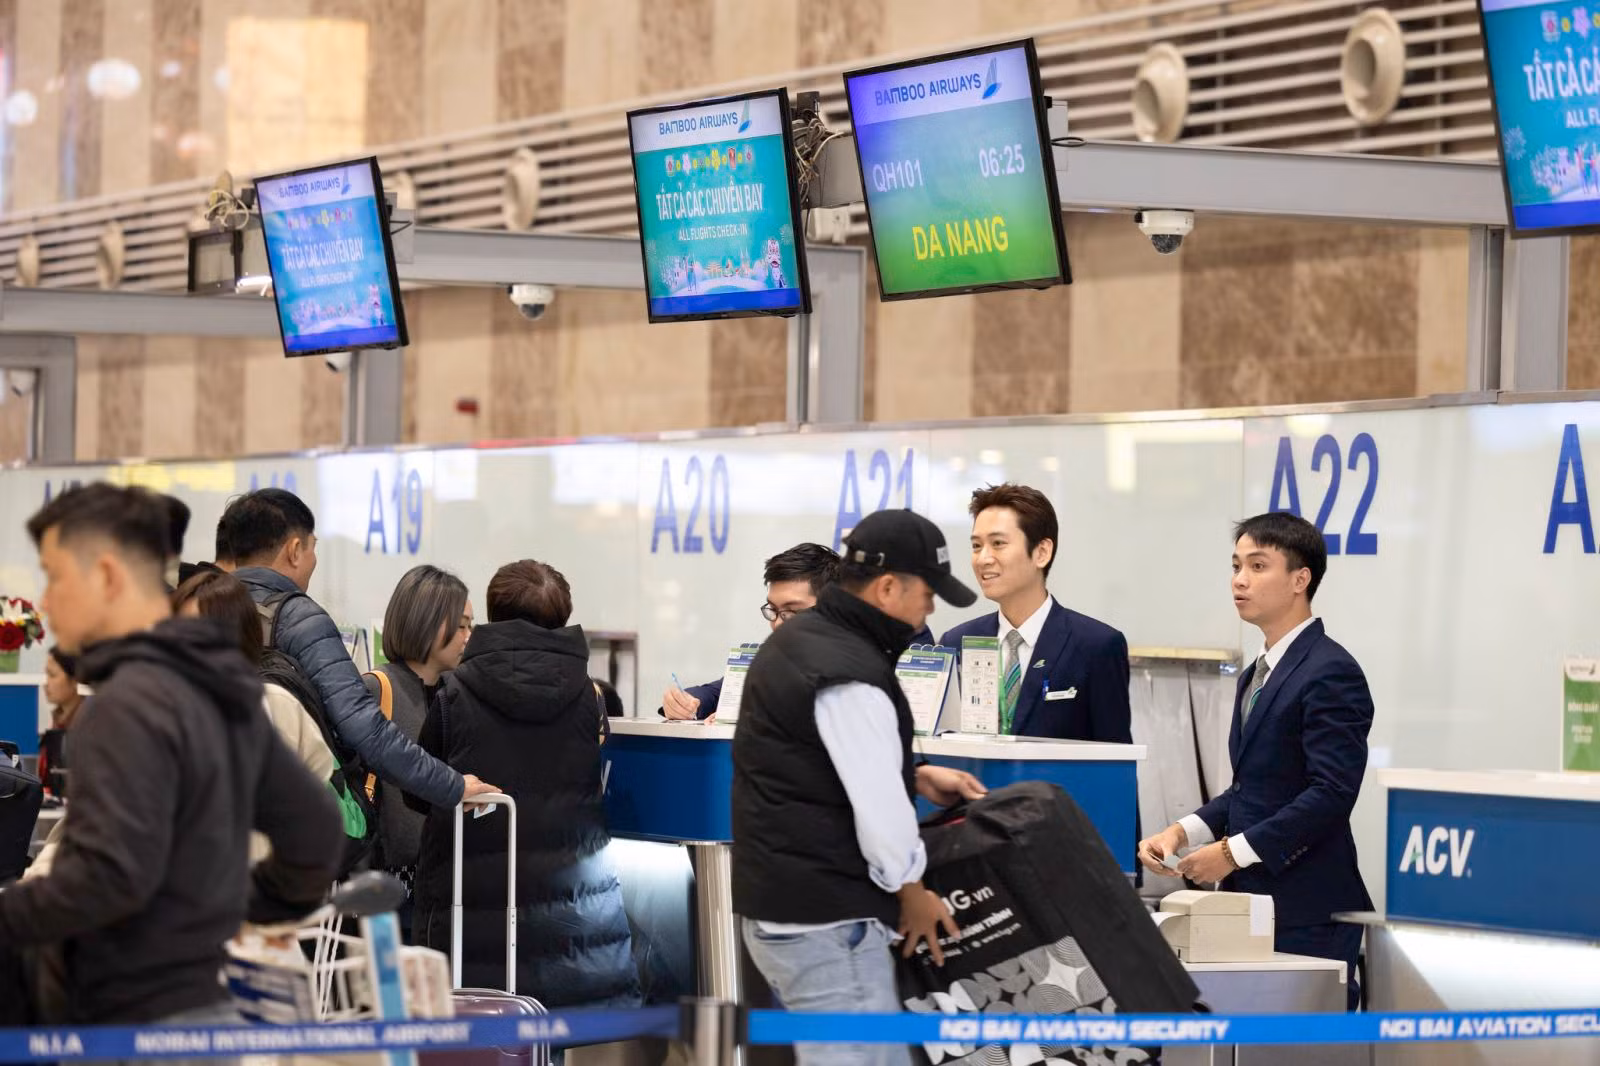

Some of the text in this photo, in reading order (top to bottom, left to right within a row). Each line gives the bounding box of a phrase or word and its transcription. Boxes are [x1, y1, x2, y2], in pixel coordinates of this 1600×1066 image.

[875, 73, 981, 106] BAMBOO AIRWAYS
[659, 112, 738, 135] BAMBOO AIRWAYS
[1566, 109, 1588, 128] ALL
[873, 144, 1025, 192] QH101 06:25
[310, 177, 340, 193] AIRWAYS
[744, 183, 763, 211] BAY
[678, 223, 748, 241] ALL FLIGHTS CHECK-IN
[912, 216, 1009, 260] DA NANG
[650, 454, 731, 555] A20
[833, 448, 914, 552] A21
[1267, 432, 1379, 556] A22
[364, 468, 423, 556] A19
[1399, 825, 1475, 877] ACV
[212, 1025, 375, 1052] INTERNATIONAL
[382, 1021, 472, 1045] AIRPORT
[940, 1019, 1230, 1041] NOI BAI AVIATION SECURITY
[1380, 1018, 1416, 1039] NOI
[1418, 1018, 1454, 1038] BAI
[1456, 1016, 1551, 1037] AVIATION
